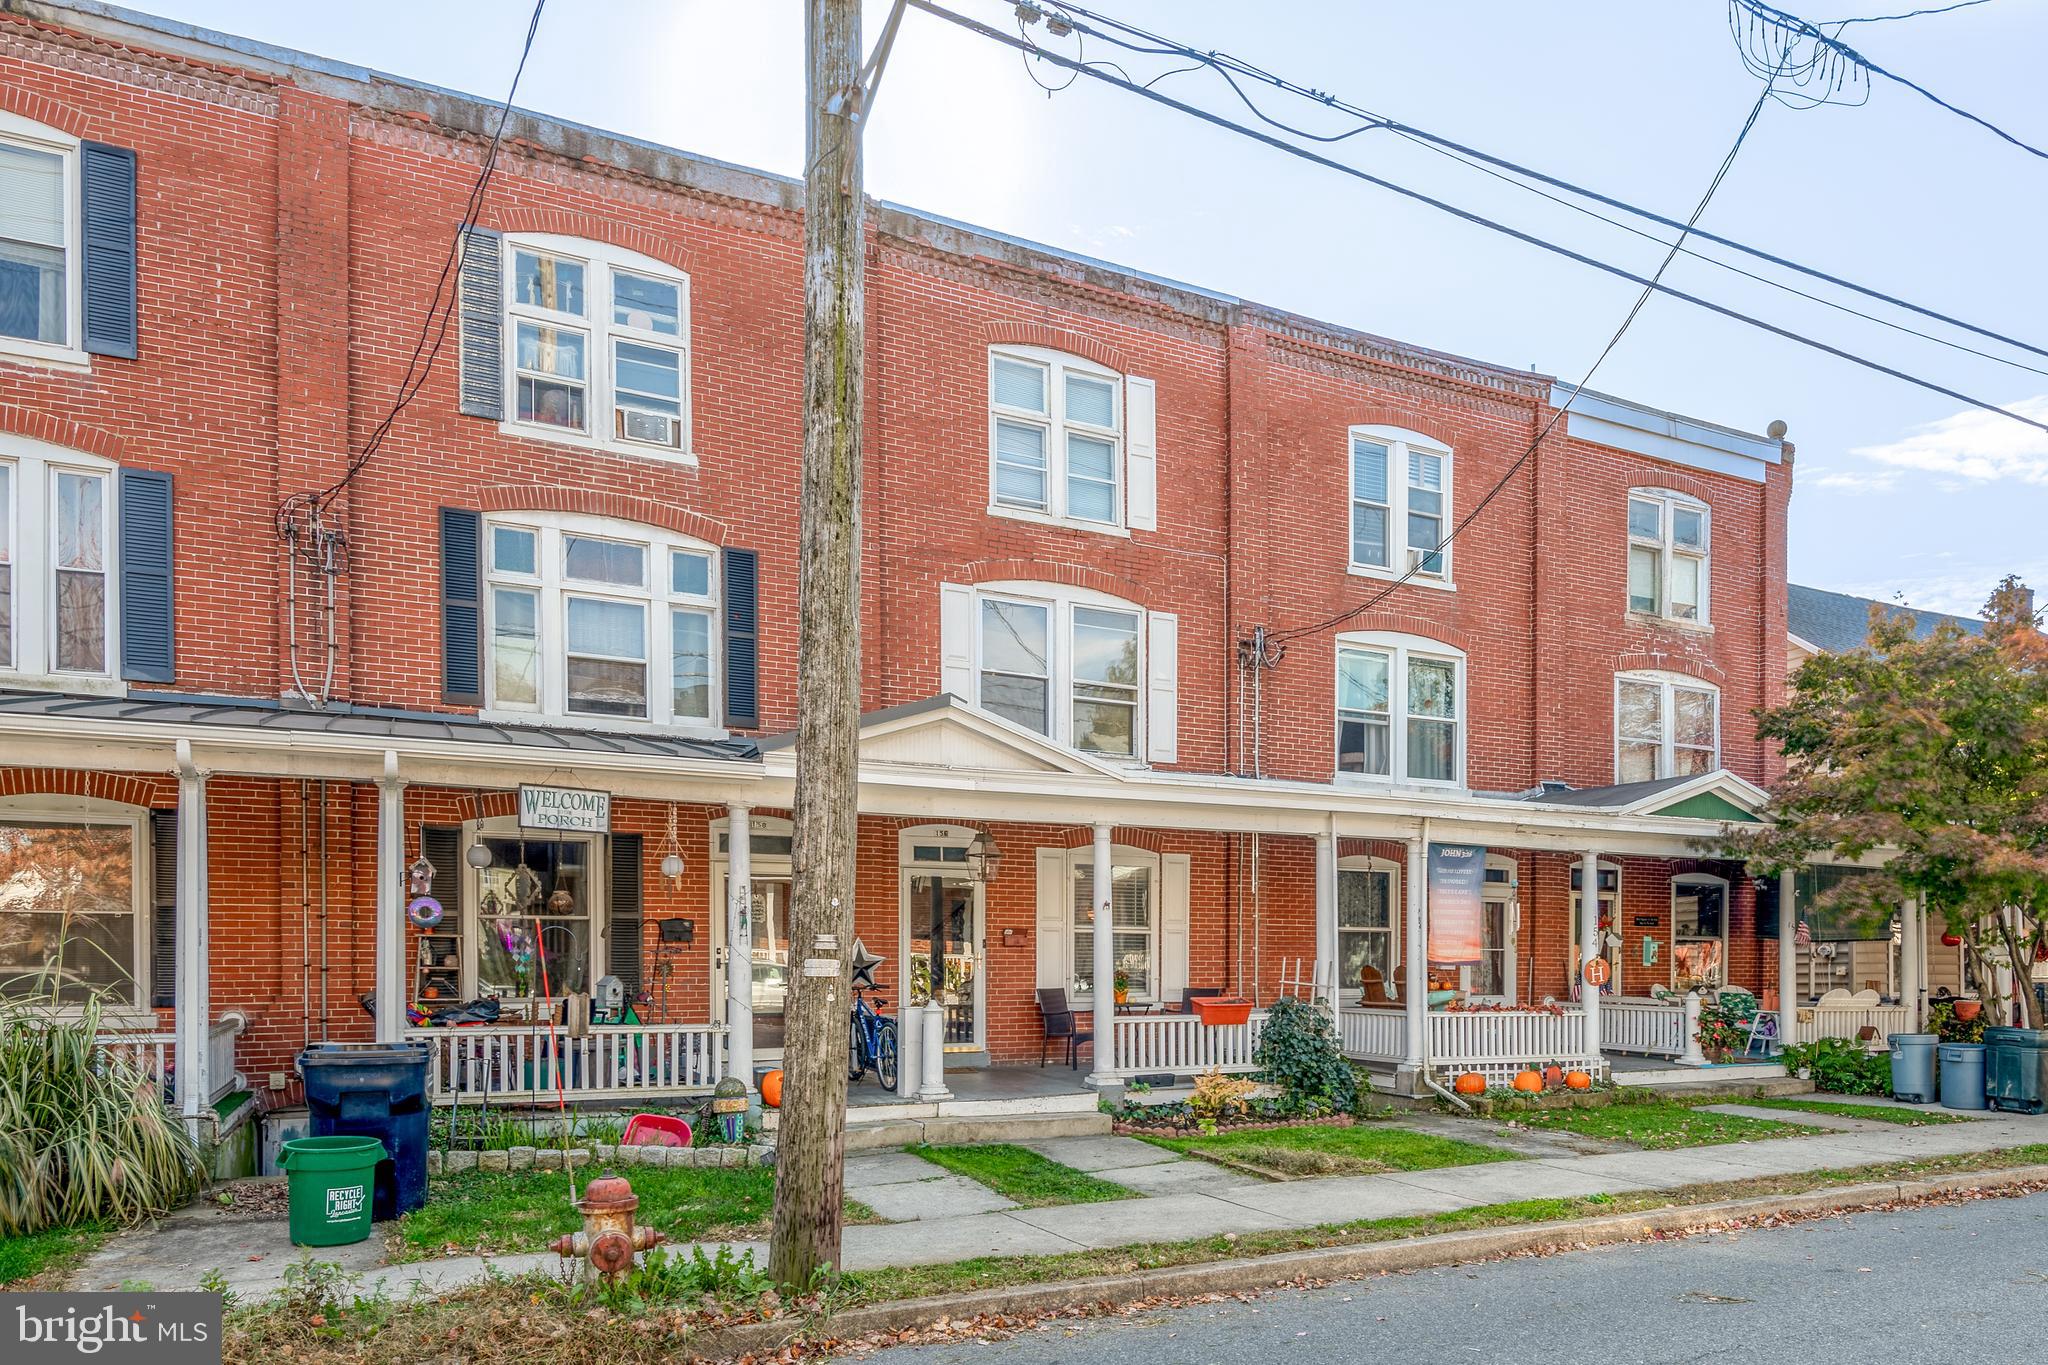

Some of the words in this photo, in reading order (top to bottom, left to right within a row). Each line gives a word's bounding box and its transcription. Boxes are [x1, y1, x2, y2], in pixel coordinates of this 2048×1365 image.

[523, 789, 606, 819] WELCOME
[537, 813, 593, 828] PORCH
[1440, 849, 1461, 858] JOHN
[1589, 966, 1605, 984] H
[329, 1188, 361, 1201] RECYCLE
[335, 1199, 357, 1211] RIGHT
